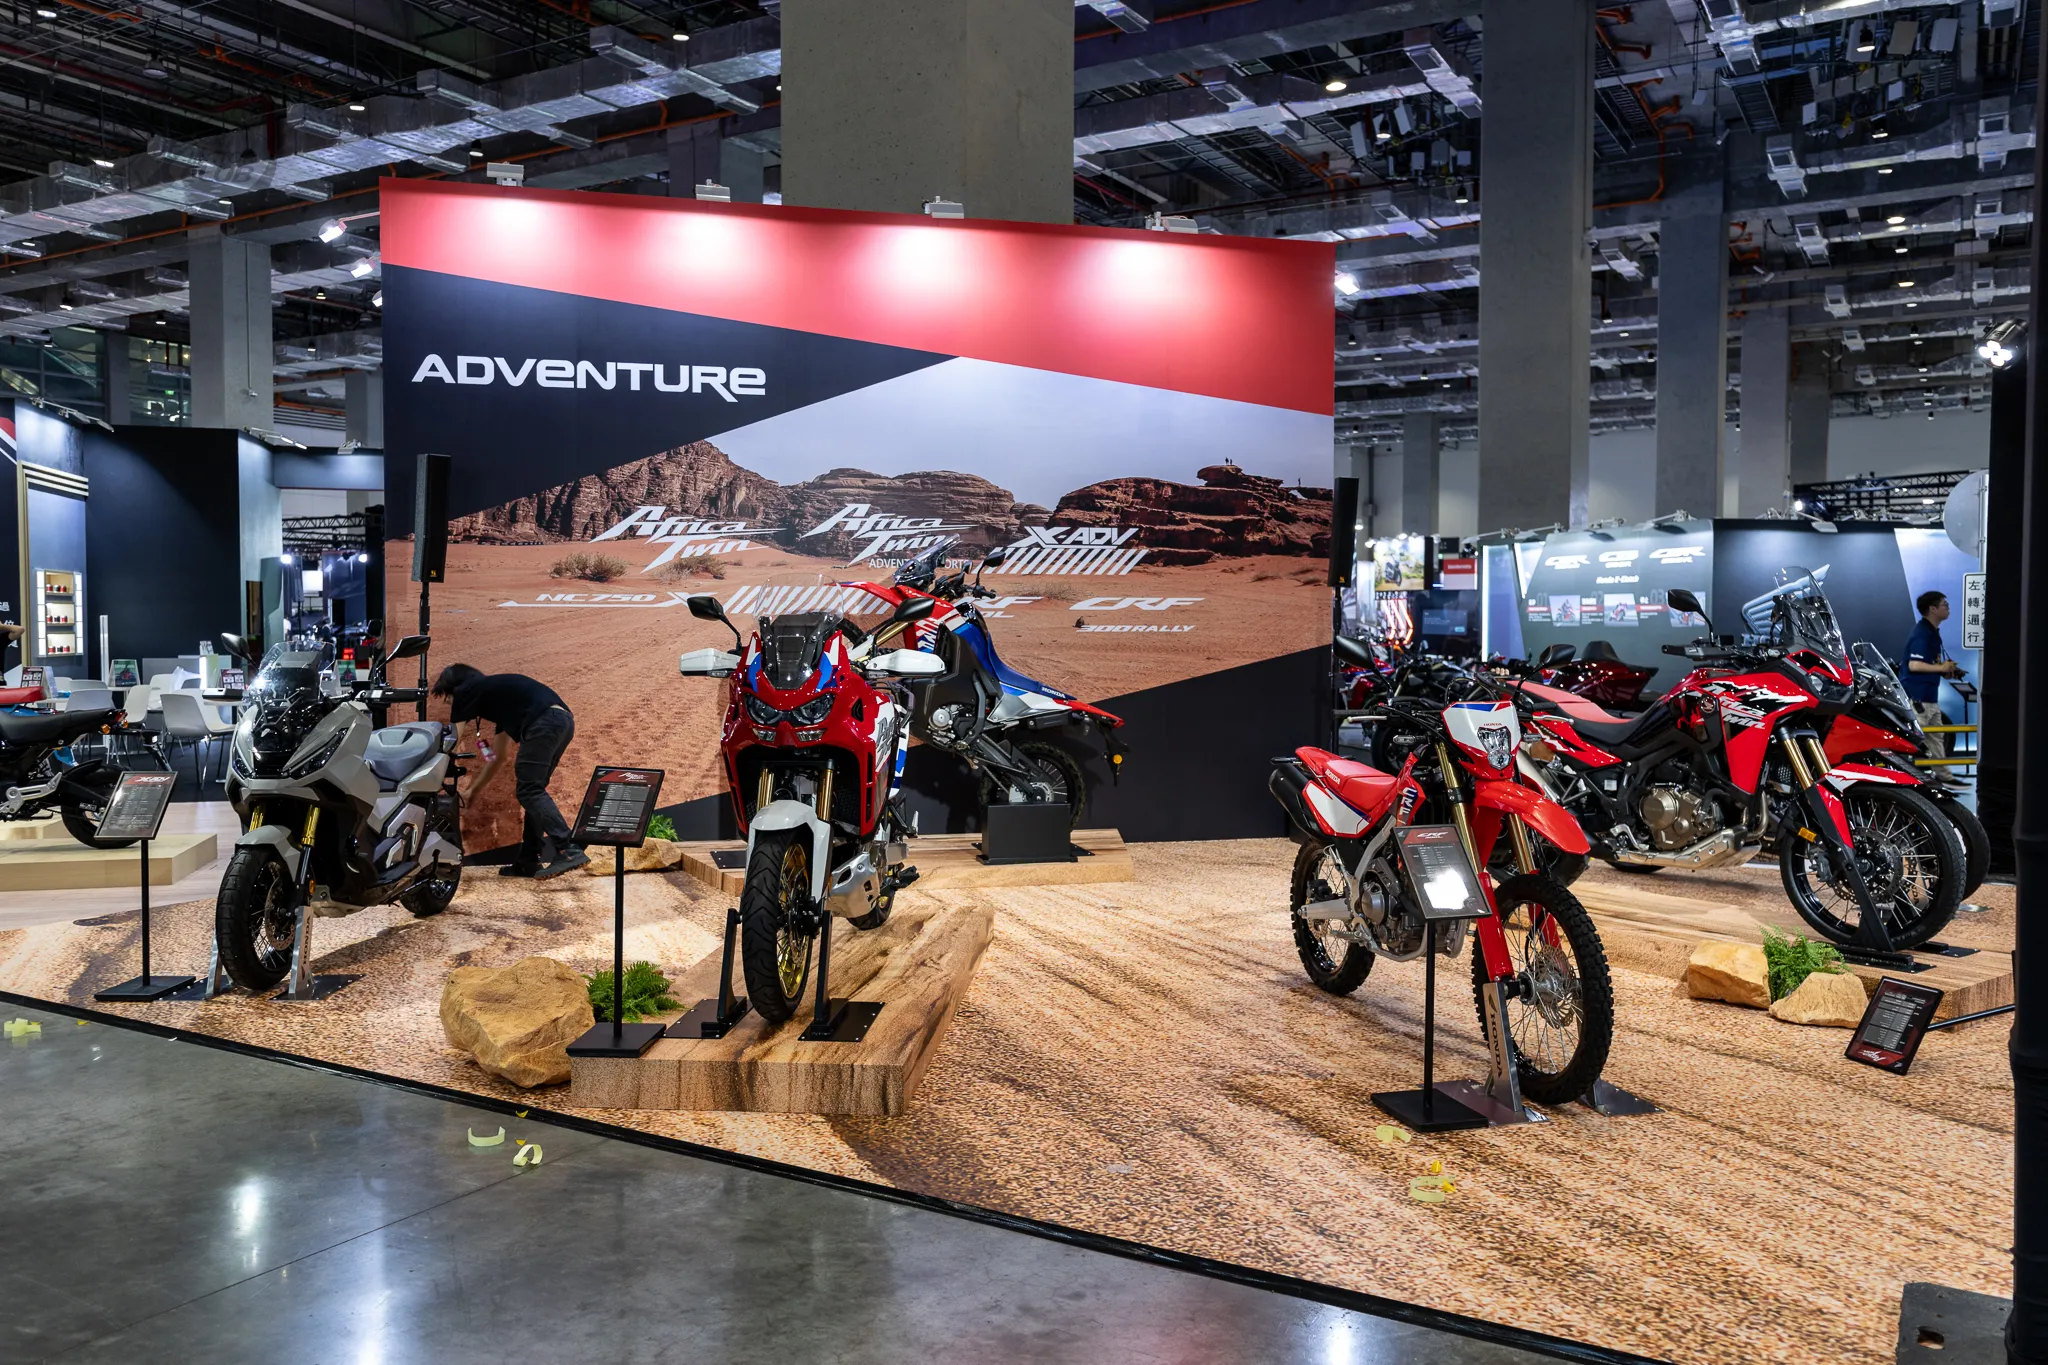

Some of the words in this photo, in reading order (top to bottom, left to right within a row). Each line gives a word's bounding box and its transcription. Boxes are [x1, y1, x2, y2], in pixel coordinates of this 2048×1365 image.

[589, 506, 787, 544] Africa
[800, 503, 978, 539] Africa
[1008, 526, 1140, 549] X-ADV
[641, 532, 769, 574] Twin
[1069, 596, 1206, 610] CRF
[1041, 686, 1066, 699] HONDA
[1489, 1013, 1502, 1079] HONDA
